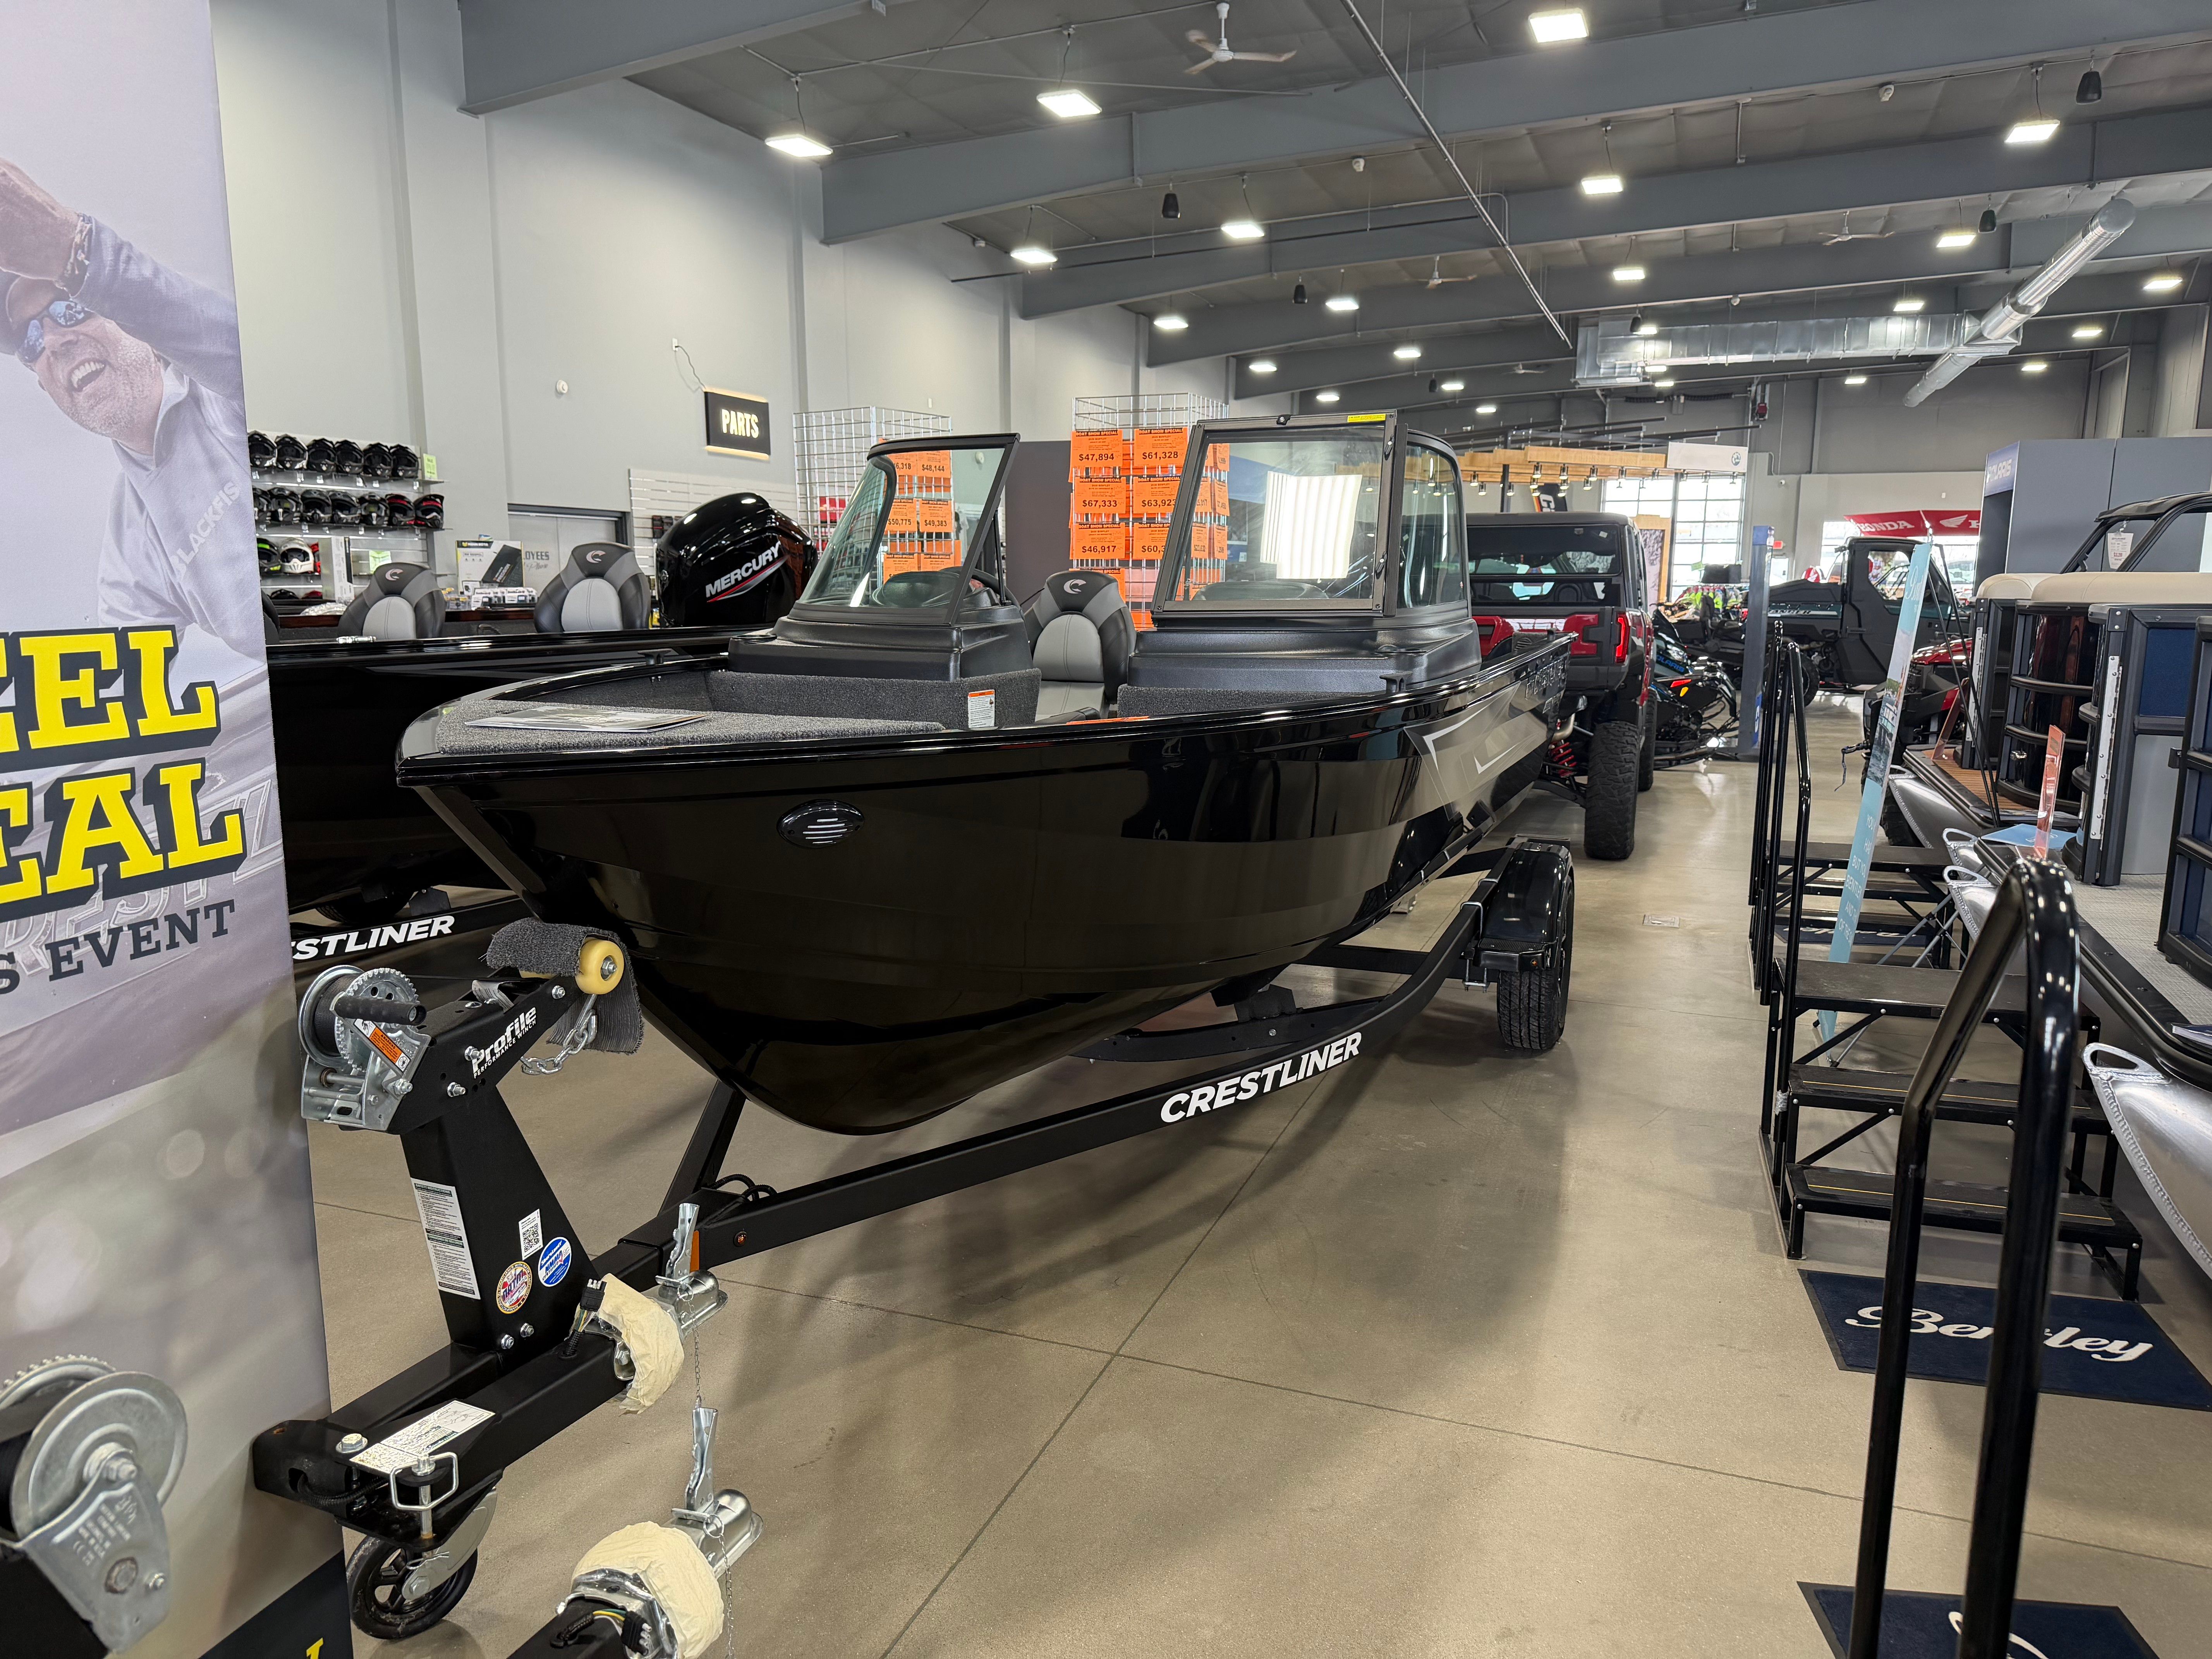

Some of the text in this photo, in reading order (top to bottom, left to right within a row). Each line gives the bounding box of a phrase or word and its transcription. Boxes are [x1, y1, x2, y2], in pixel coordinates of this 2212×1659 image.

[722, 409, 759, 438] PARTS
[1079, 453, 1114, 462] $47,894
[1142, 451, 1178, 460] $61,328
[894, 462, 911, 471] 6,318
[922, 464, 945, 472] $48,144
[1082, 500, 1117, 508] $67,333
[1082, 545, 1116, 554] $46,917
[1142, 545, 1165, 554] $60,3
[705, 541, 781, 598] MERCURY
[1656, 655, 1685, 673] OLARIS
[0, 628, 219, 755] EL
[45, 898, 235, 982] EVENT
[292, 915, 455, 960] STLINER
[474, 1019, 536, 1079] PERFORMANCE WINCH
[1161, 1032, 1362, 1123] CRESTLINER
